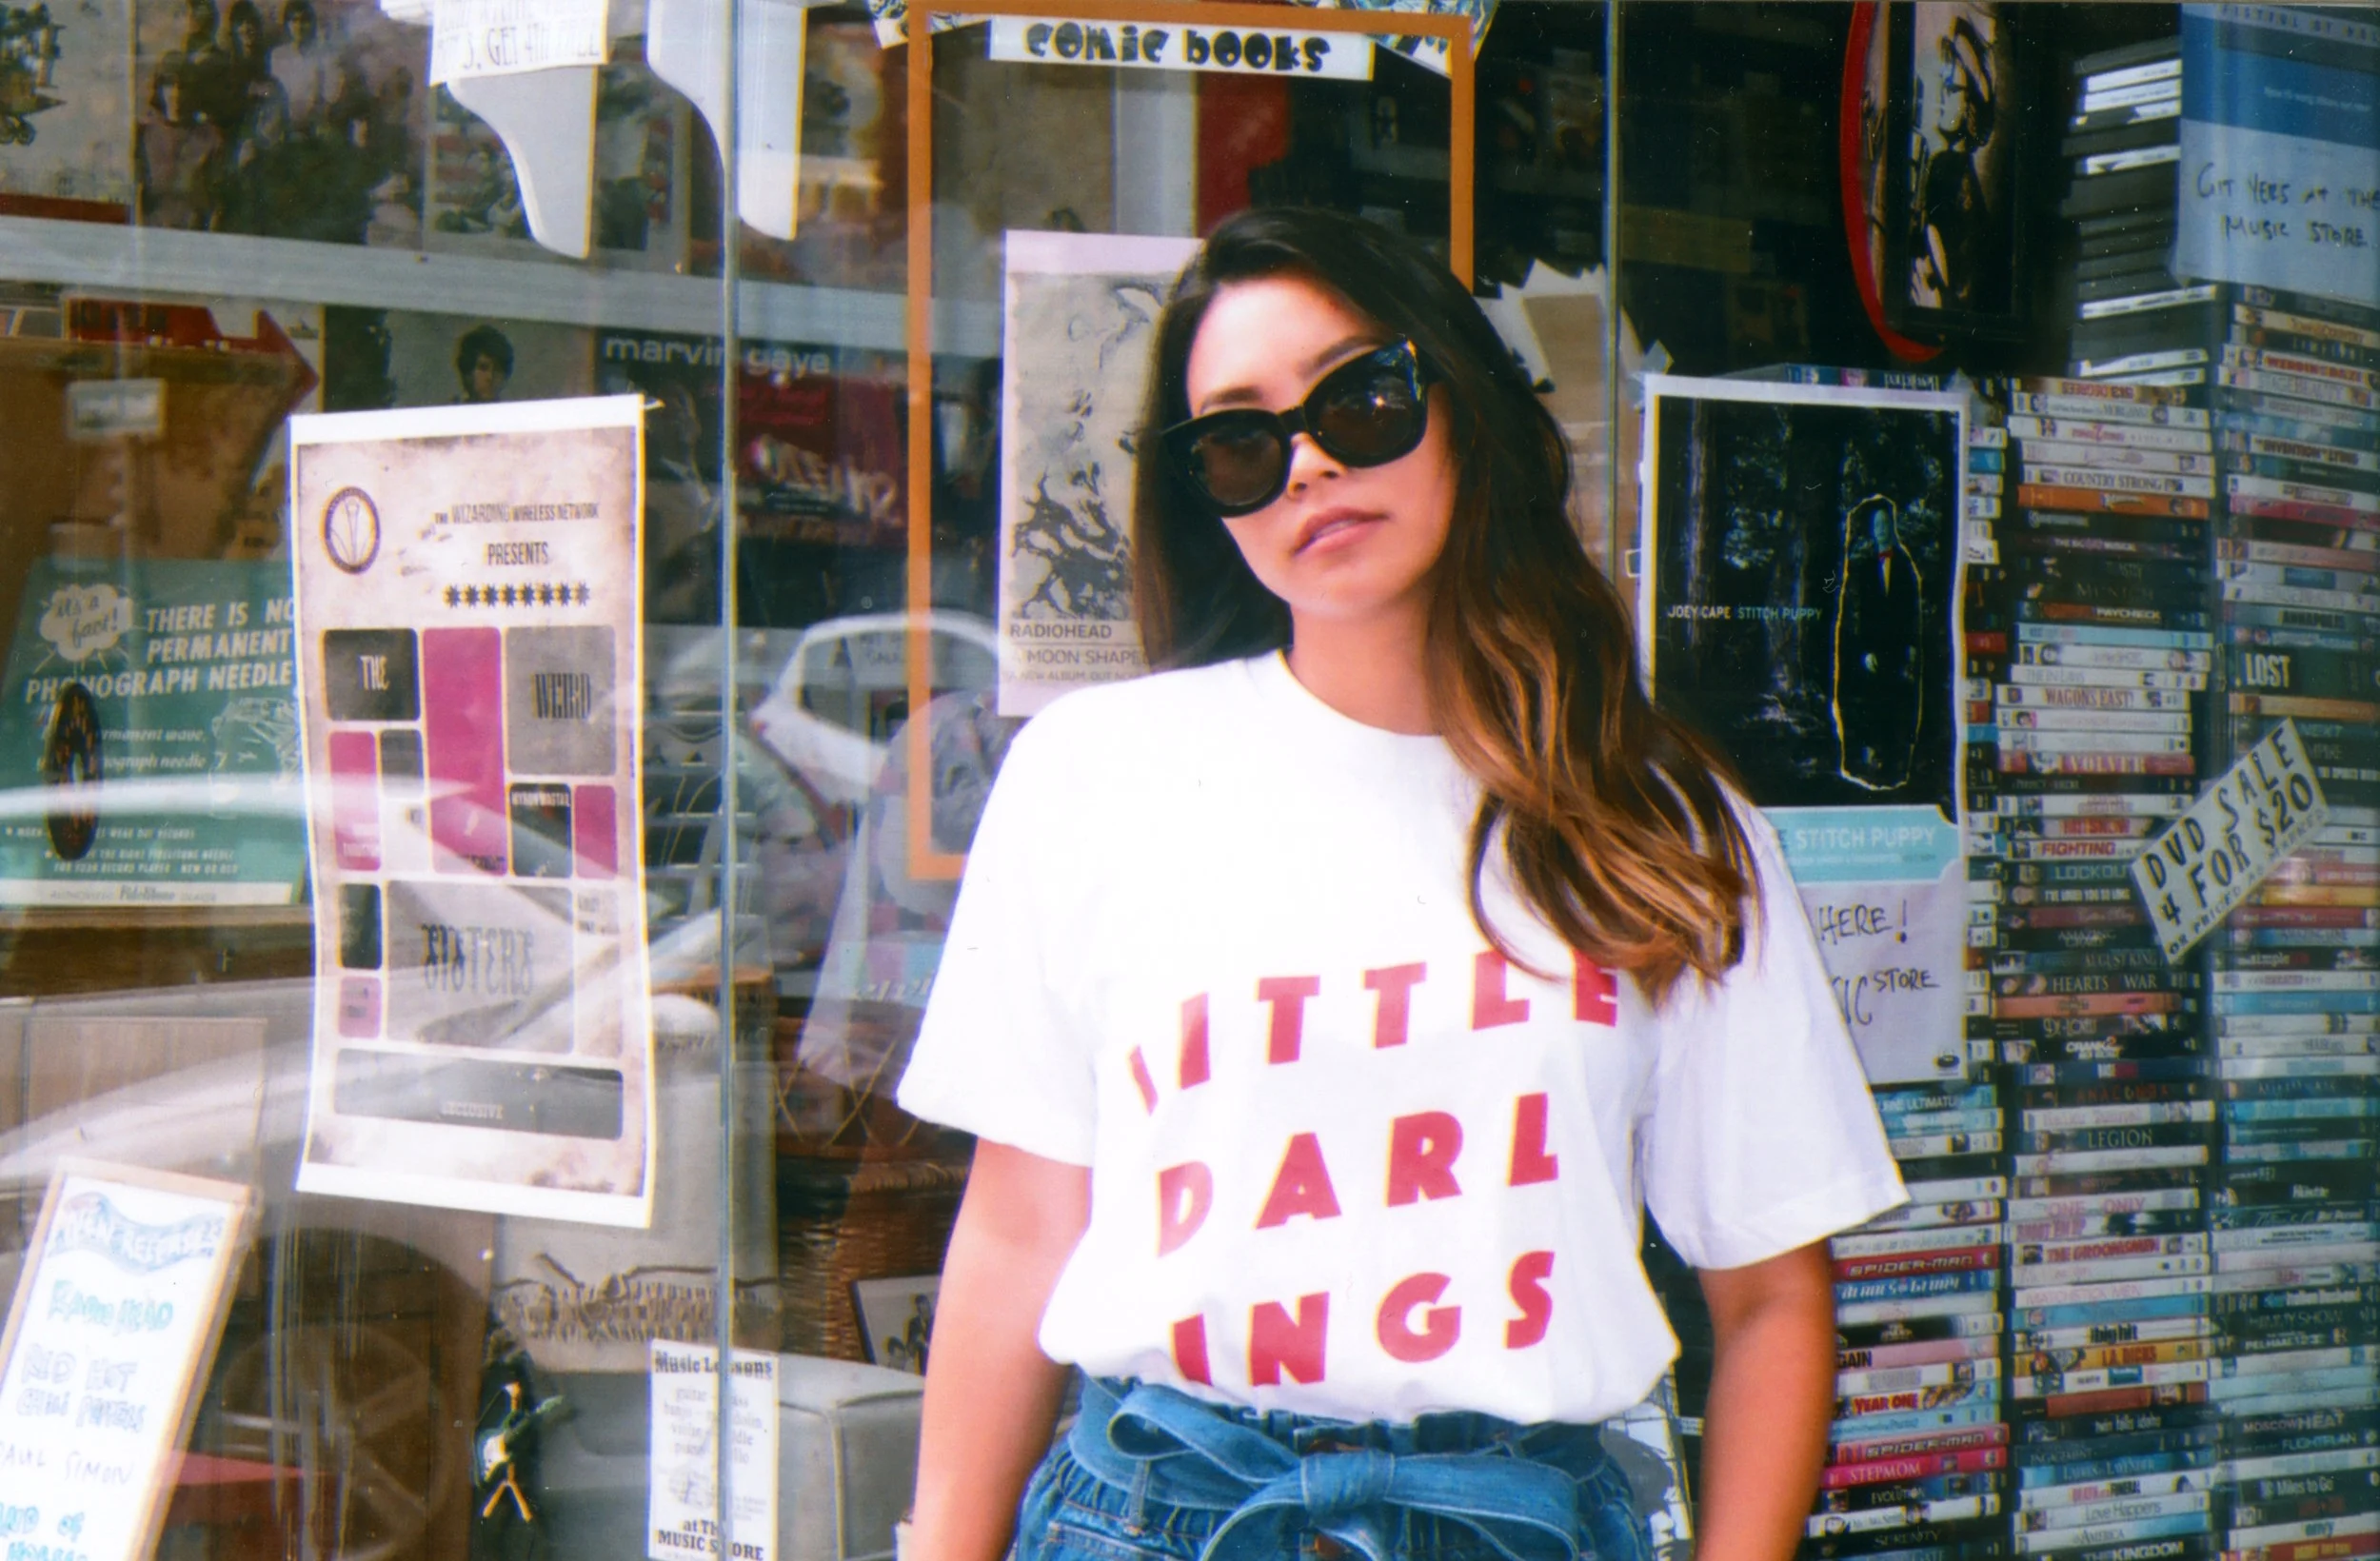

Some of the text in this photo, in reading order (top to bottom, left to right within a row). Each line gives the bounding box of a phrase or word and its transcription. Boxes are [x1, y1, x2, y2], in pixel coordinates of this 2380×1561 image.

[2309, 220, 2368, 247] STORE
[605, 335, 830, 379] marvin gaye
[2063, 470, 2163, 492] COUNTRY STRONG
[449, 503, 510, 524] WIZARDING
[510, 504, 557, 523] WIRELESS
[557, 502, 601, 521] NETWORK
[485, 541, 549, 566] PRESENTS
[144, 603, 218, 634] THERE
[227, 601, 249, 628] IS
[1667, 603, 1823, 621] JOEY CAPE STITCH PUPPY
[1009, 622, 1112, 639] RADIOHEAD
[147, 628, 293, 664] PERMANENT
[1026, 649, 1081, 666] MOON
[207, 660, 293, 692] NEEDLE
[2243, 651, 2291, 689] LOST
[2043, 686, 2097, 707] WAGONS
[2142, 726, 2295, 890] DVD SALE
[1795, 826, 1866, 850] STITCH
[1871, 825, 1937, 848] PUPPY
[2039, 841, 2116, 857] FIGHTING
[2158, 772, 2314, 927] 4 FOR $20
[1873, 968, 1941, 994] STORE
[2123, 973, 2158, 990] WAR
[2087, 1129, 2154, 1150] LEGION
[1156, 1092, 1561, 1259] DARL
[1848, 1254, 1973, 1278] SPIDER-MAN
[1170, 1251, 1557, 1387] INGS
[654, 1349, 774, 1380] Music Lesons
[1837, 1349, 1873, 1369] GAIN
[1854, 1392, 1919, 1414] YEAR ONE
[2297, 1406, 2346, 1432] HEAT
[0, 1440, 47, 1469] AUL
[1865, 1432, 1987, 1459] SPIDER-MAN
[1849, 1459, 1923, 1483] STEPMOM
[656, 1529, 767, 1561] MUSIC SORE
[2112, 1540, 2185, 1561] KINGDOM
